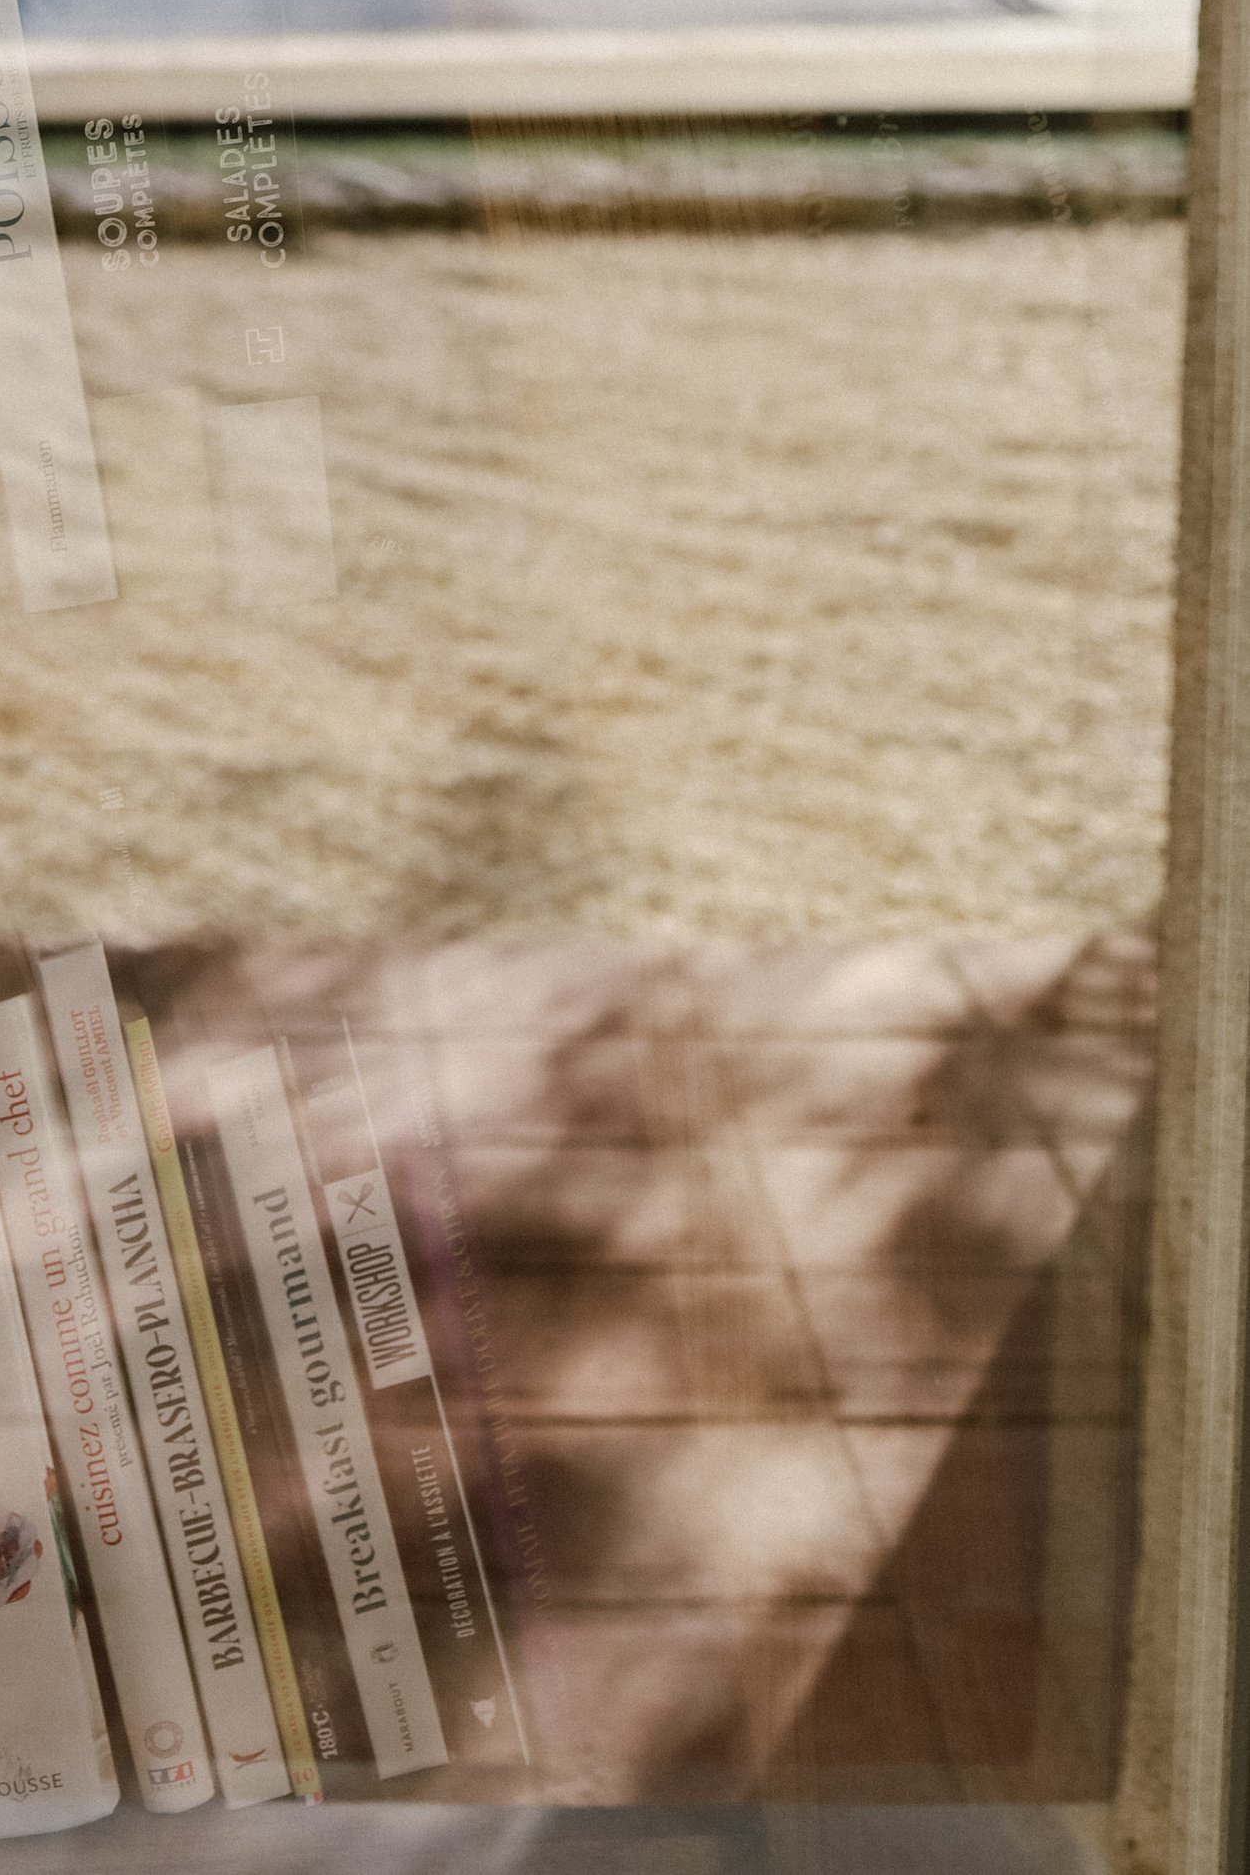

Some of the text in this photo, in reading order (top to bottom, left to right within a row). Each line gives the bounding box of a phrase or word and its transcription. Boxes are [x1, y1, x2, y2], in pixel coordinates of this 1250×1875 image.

[85, 117, 131, 272] SOUPES
[122, 114, 160, 268] COMPLÈTES
[215, 106, 252, 242] SALADES
[243, 72, 286, 269] COMPLÈTES
[38, 440, 68, 553] Flammarion
[70, 1008, 96, 1078] GUILLOT
[87, 1004, 110, 1056] AMIEL
[7, 1146, 65, 1242] grand
[40, 1247, 66, 1293] un
[67, 1225, 99, 1326] Robuchon
[345, 1241, 418, 1373] WORKSHOP
[52, 1298, 94, 1415] comme
[84, 1329, 113, 1370] Joël
[101, 1375, 120, 1401] par
[251, 1183, 390, 1618] Breakfast gourmand
[110, 1171, 245, 1672] BARBECUE-BRASERO-PLANCHA
[77, 1423, 124, 1547] cuisinez
[387, 1680, 415, 1755] MARABOUT
